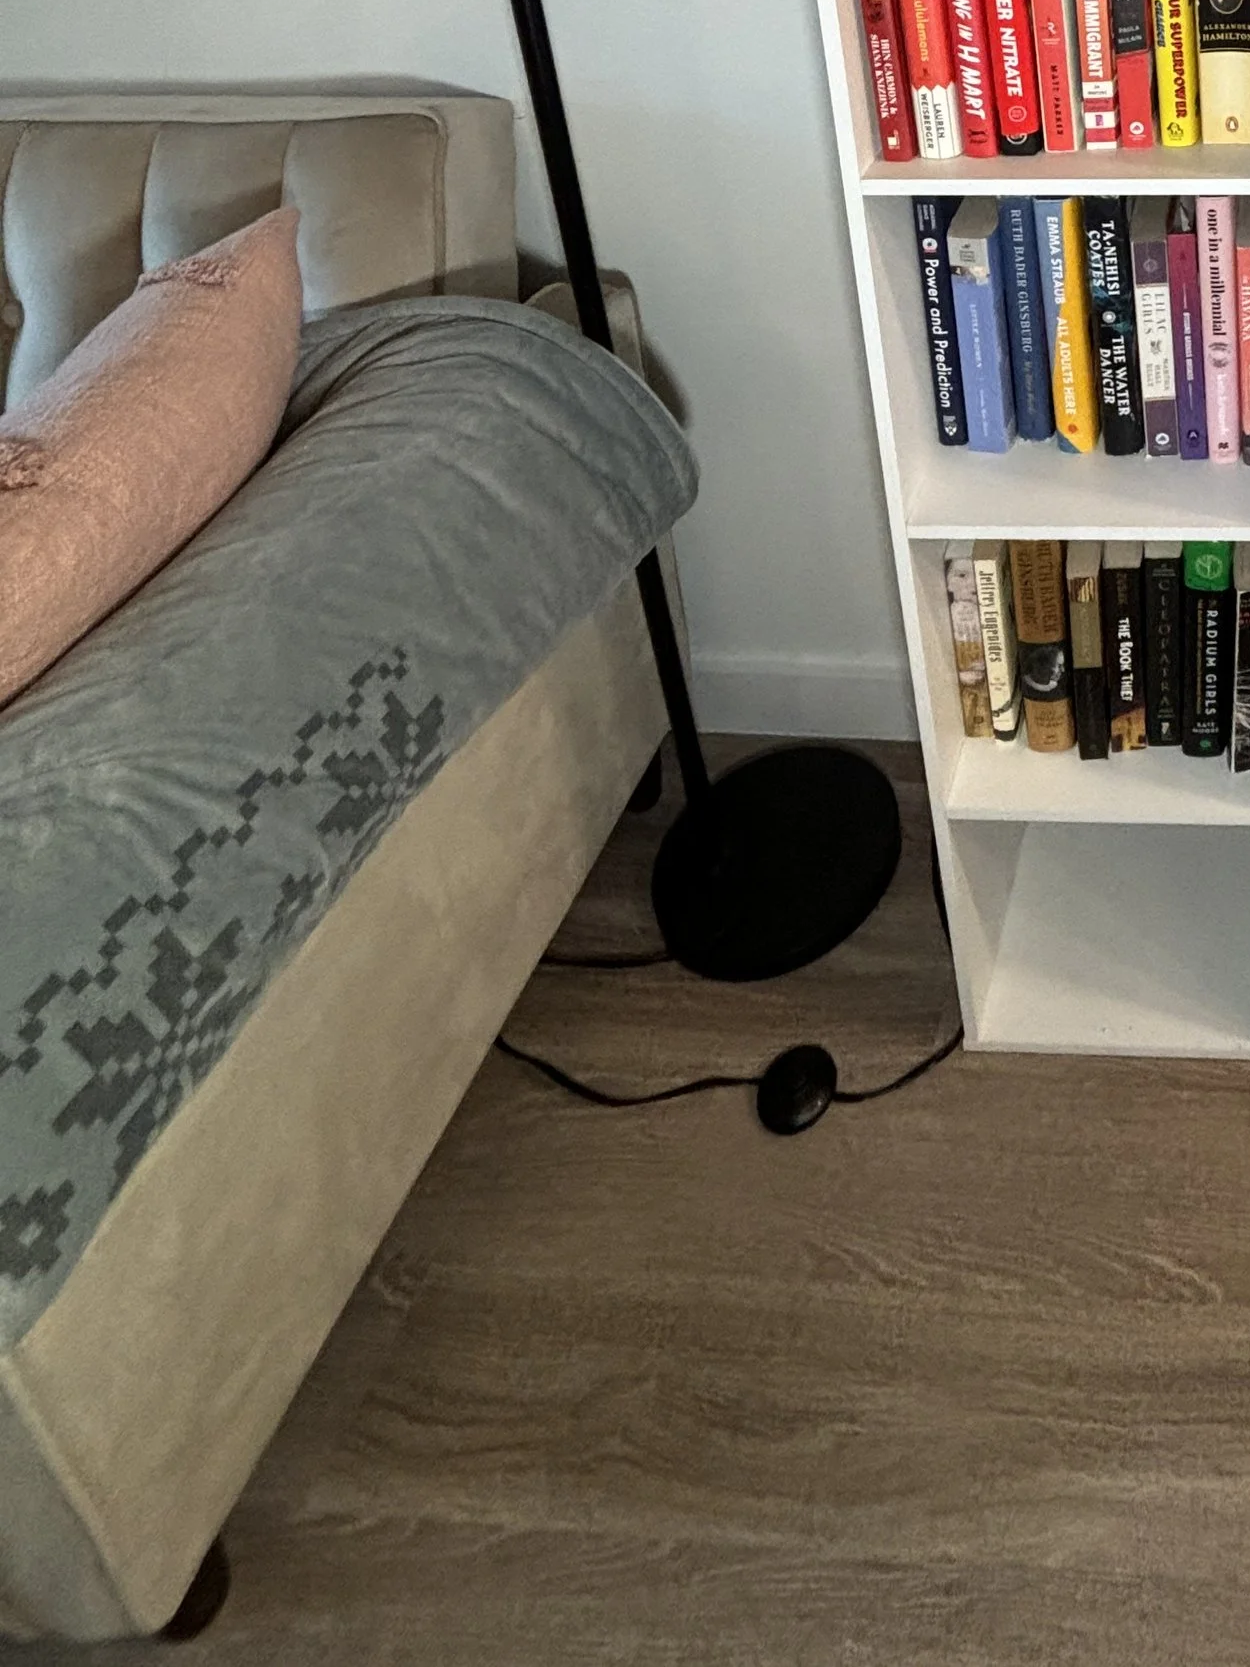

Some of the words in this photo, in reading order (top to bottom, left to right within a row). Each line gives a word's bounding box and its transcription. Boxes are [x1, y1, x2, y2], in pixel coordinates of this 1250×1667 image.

[1000, 27, 1022, 98] NITRATE
[1170, 21, 1187, 119] SUPERPOWER
[960, 64, 986, 120] MART
[920, 93, 935, 150] WEISBERGER
[933, 102, 945, 139] LAUREN
[1010, 208, 1022, 241] RUTH
[1046, 216, 1060, 256] EMMA
[1207, 209, 1218, 232] one
[1088, 230, 1104, 288] COATES
[1101, 220, 1119, 296] TA-NEHISI
[1208, 235, 1222, 251] in
[924, 258, 939, 304] Power
[1050, 258, 1065, 305] STRAUB
[1209, 264, 1227, 336] millennial
[930, 307, 943, 336] and
[1015, 290, 1033, 354] GINSBURG
[1056, 316, 1068, 337] ALL
[1141, 293, 1153, 335] GIRLS
[1154, 293, 1167, 334] LILAC
[1058, 341, 1073, 383] ADULTS
[1111, 335, 1125, 361] THE
[933, 337, 952, 409] Prediction
[1100, 347, 1116, 405] DANCER
[1115, 364, 1131, 417] WATER
[1062, 384, 1076, 415] HERE
[1118, 618, 1131, 639] THE
[1206, 609, 1219, 667] RADIUM
[1119, 641, 1133, 671] BOOK
[1120, 673, 1134, 702] THIEF
[1204, 673, 1218, 716] GIRLS
